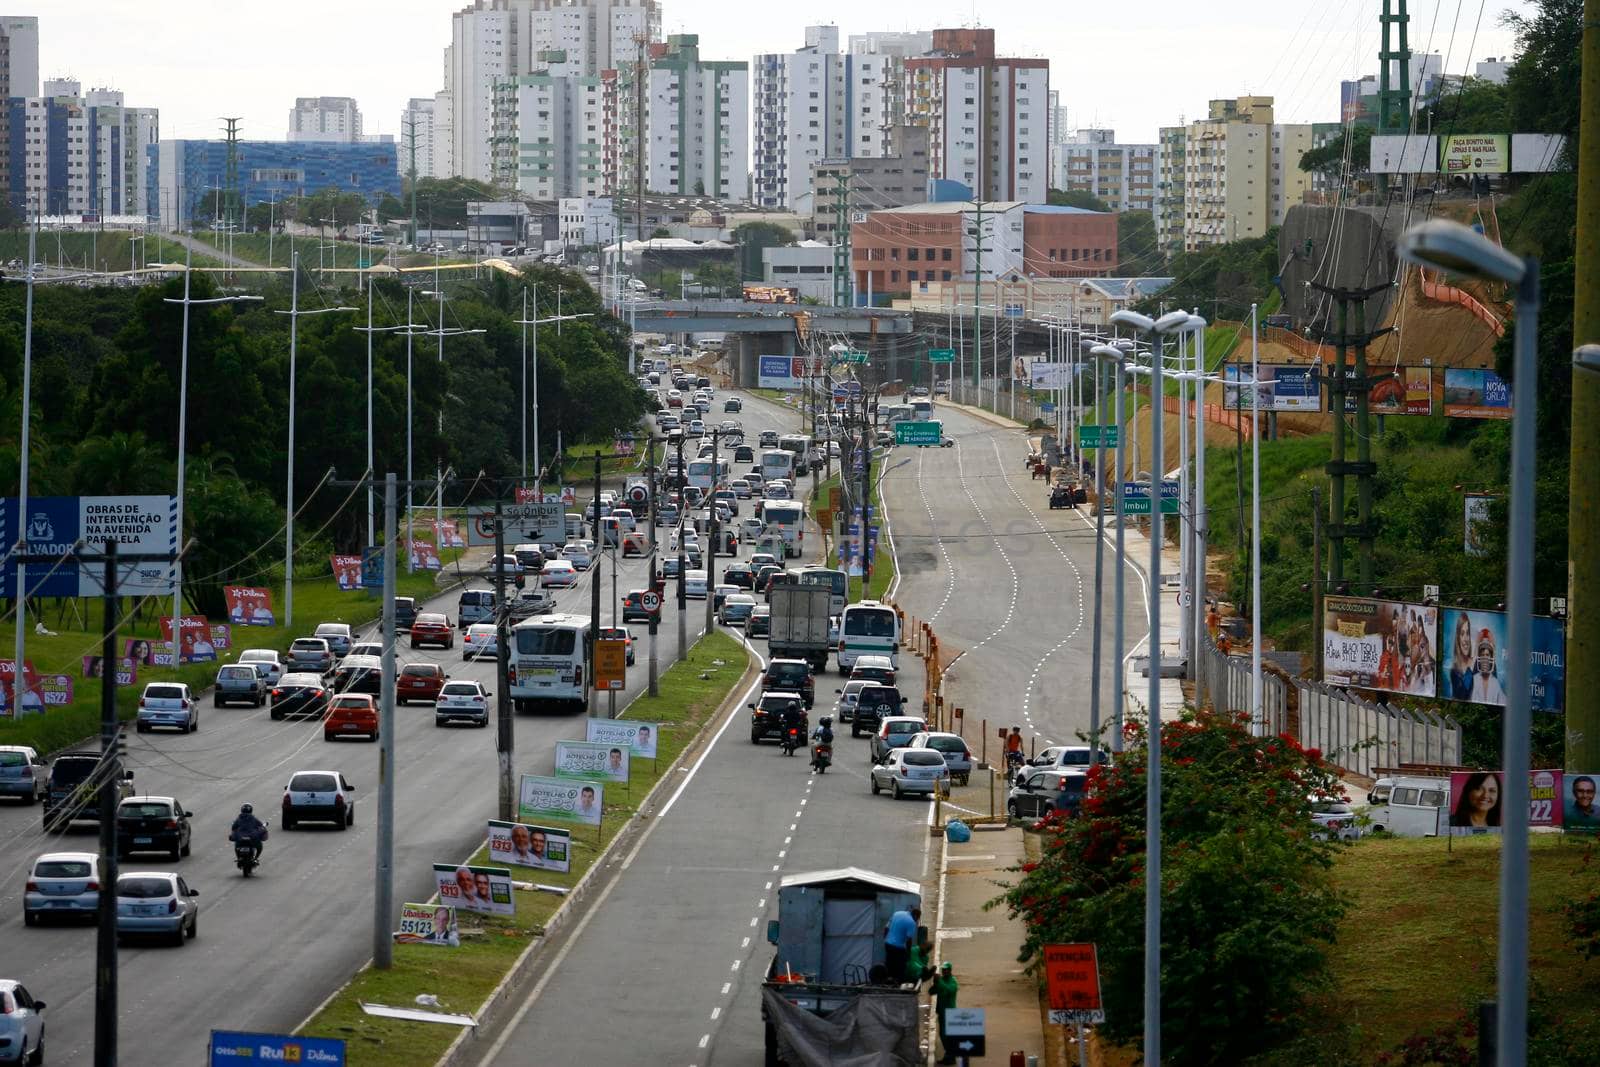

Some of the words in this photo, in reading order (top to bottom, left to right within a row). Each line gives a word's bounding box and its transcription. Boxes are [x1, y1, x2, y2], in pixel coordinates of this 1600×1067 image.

[1486, 382, 1506, 391] NOVA
[1487, 391, 1506, 400] ORLA
[86, 505, 123, 514] OBRAS
[125, 505, 139, 514] DE
[524, 504, 559, 516] Ônibus
[86, 513, 161, 526] INTERVENÇÃO
[86, 525, 102, 534] NA
[104, 525, 151, 534] AVENIDA
[242, 588, 266, 598] Dilma
[643, 595, 659, 606] 80
[178, 617, 204, 627] Dilma
[44, 691, 67, 704] 6522
[566, 752, 597, 761] BOTELHO
[531, 789, 566, 798] BOTELHO
[403, 909, 433, 920] Ubaldino
[401, 920, 432, 933] 55123
[307, 1049, 339, 1062] Dilma
